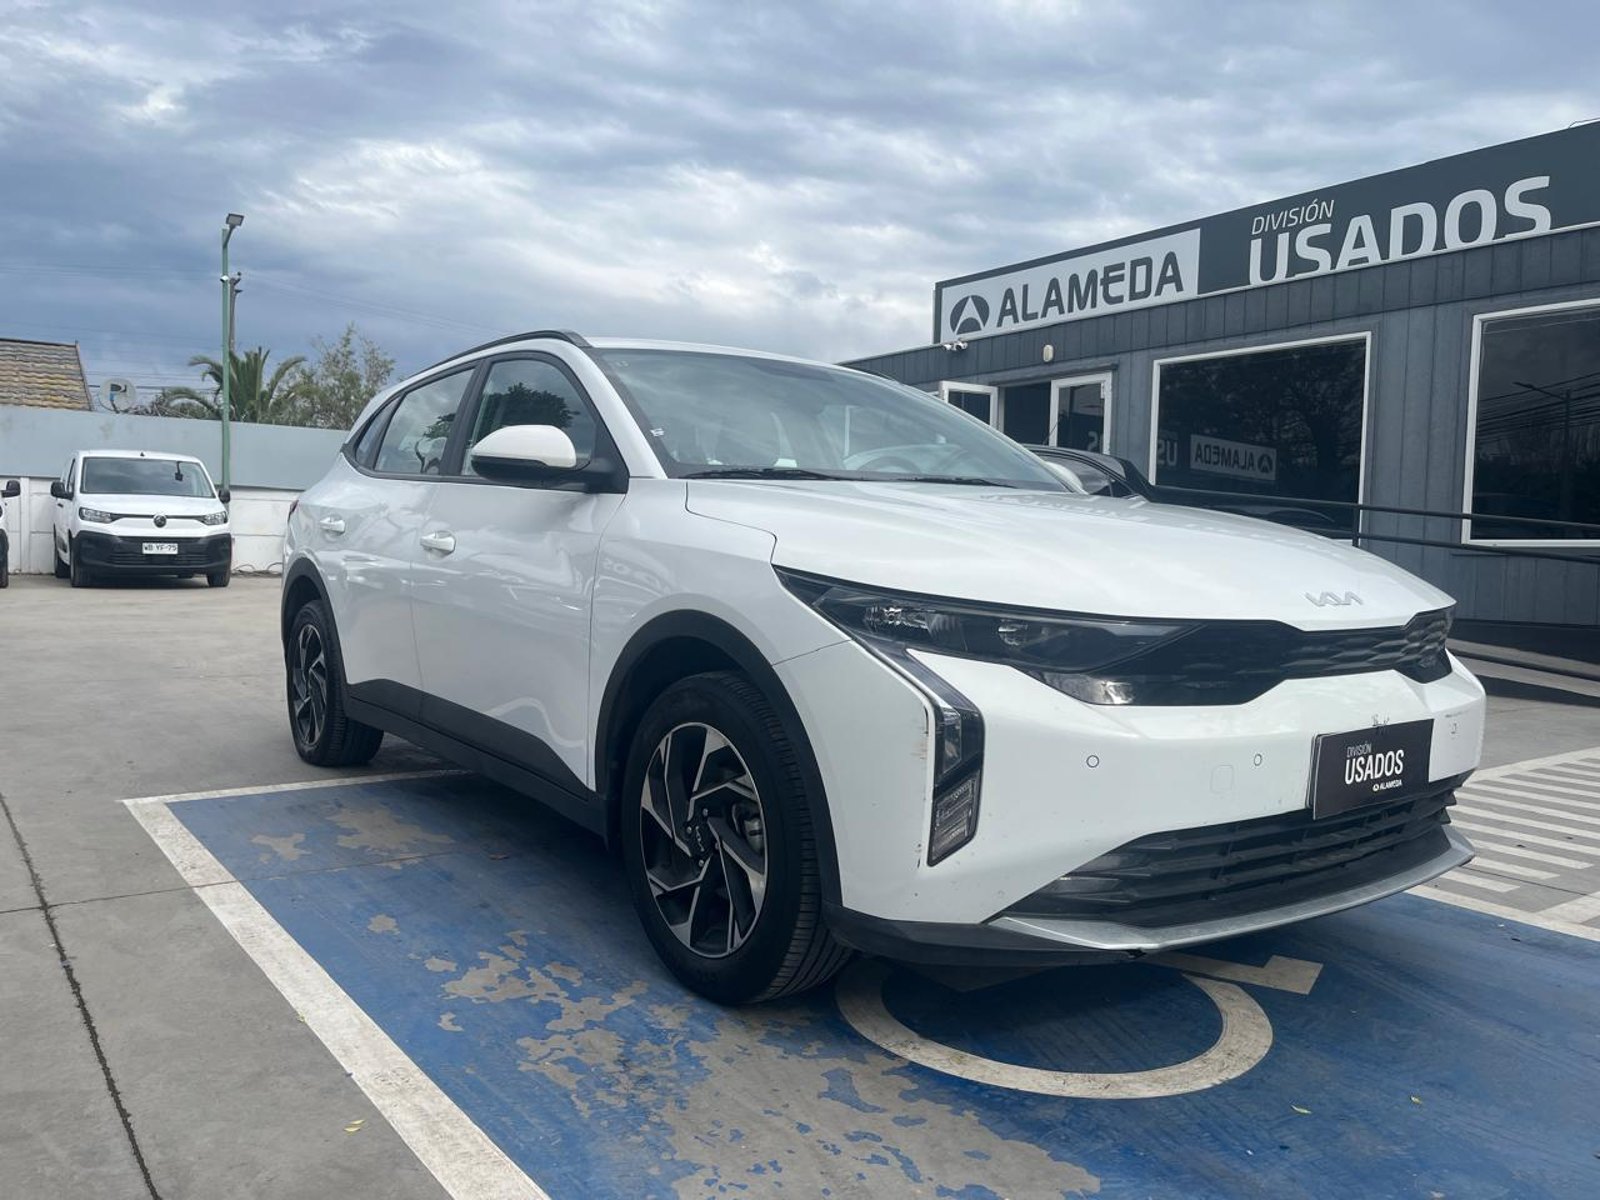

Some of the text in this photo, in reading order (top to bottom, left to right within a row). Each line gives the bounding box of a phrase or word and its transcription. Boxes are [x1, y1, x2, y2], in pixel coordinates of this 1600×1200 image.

[1249, 176, 1551, 286] USADOS
[1251, 199, 1335, 235] DIVISIÓN
[996, 251, 1184, 328] ALAMEDA
[1345, 749, 1405, 785] USADOS
[1379, 779, 1403, 790] ALAMEDA
